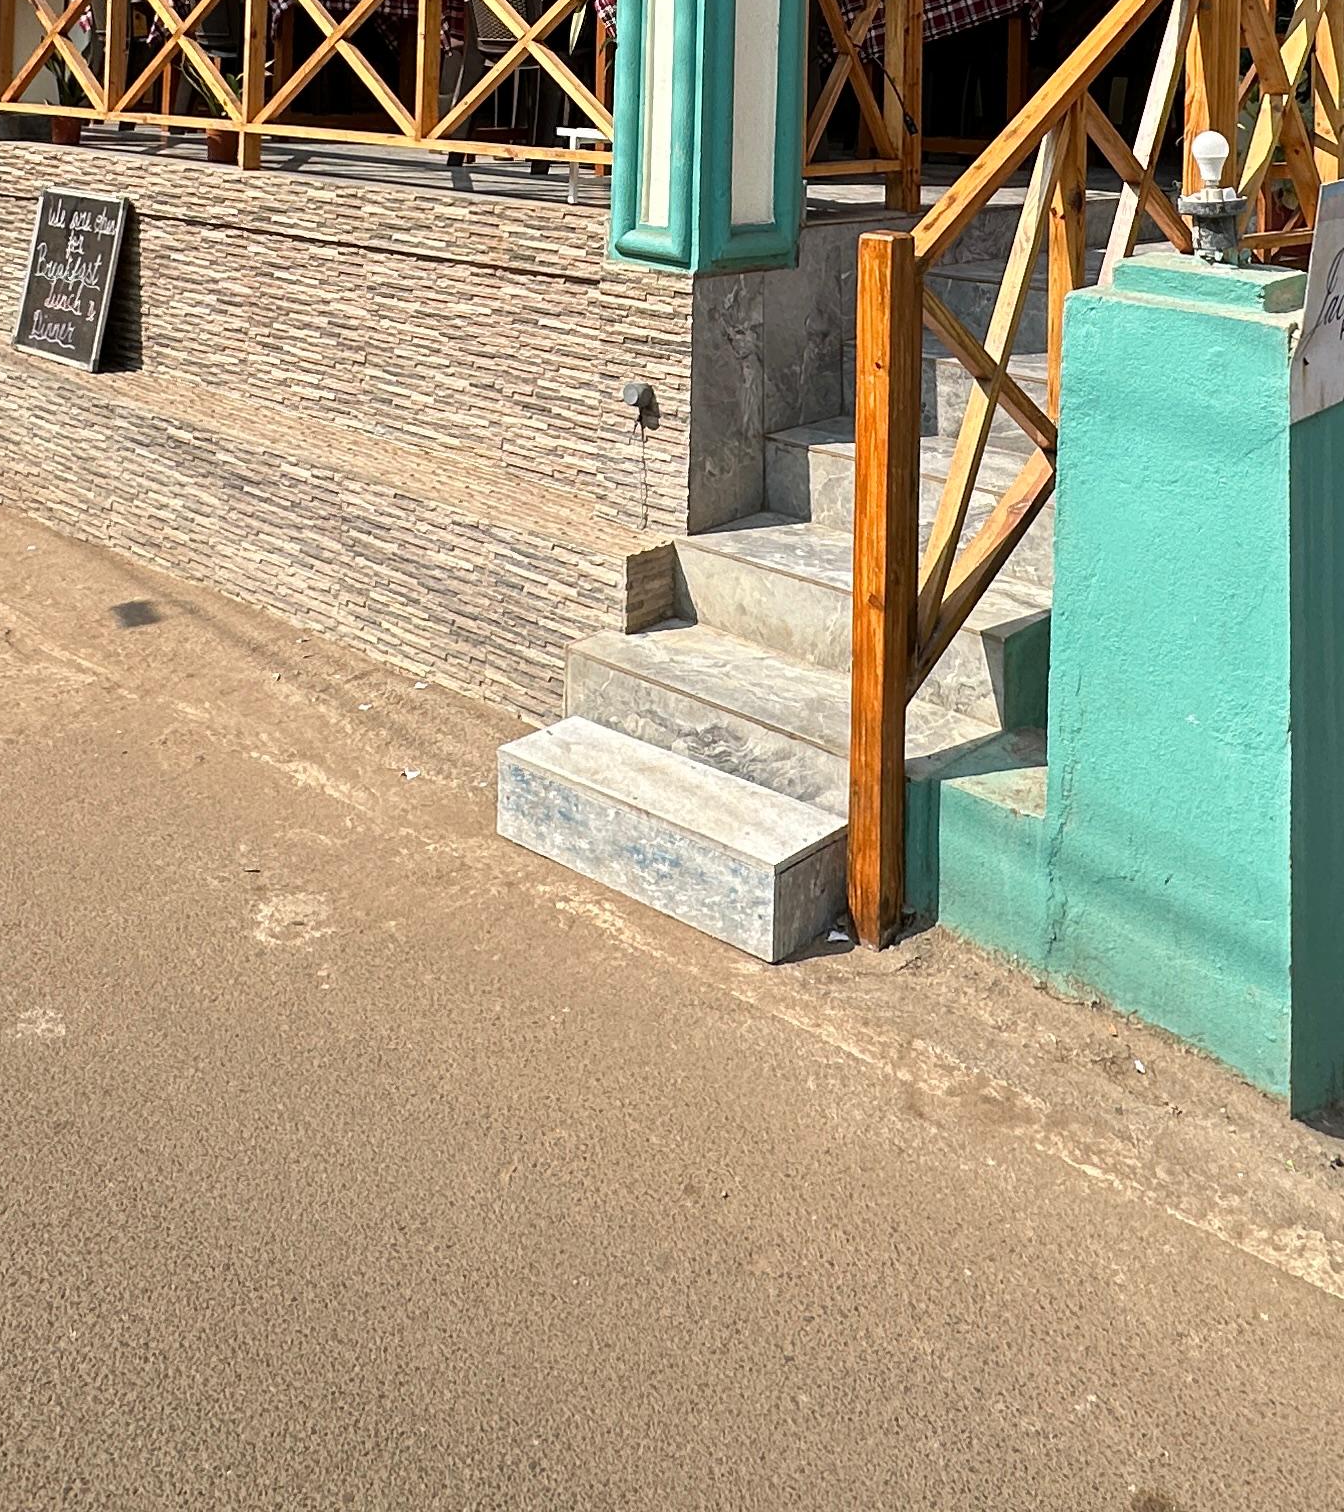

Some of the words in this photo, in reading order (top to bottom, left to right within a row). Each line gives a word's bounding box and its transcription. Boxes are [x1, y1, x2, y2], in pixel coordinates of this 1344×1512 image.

[70, 211, 92, 231] are
[66, 231, 84, 258] for
[35, 243, 102, 290] Breakfast
[31, 309, 75, 343] Dinner
